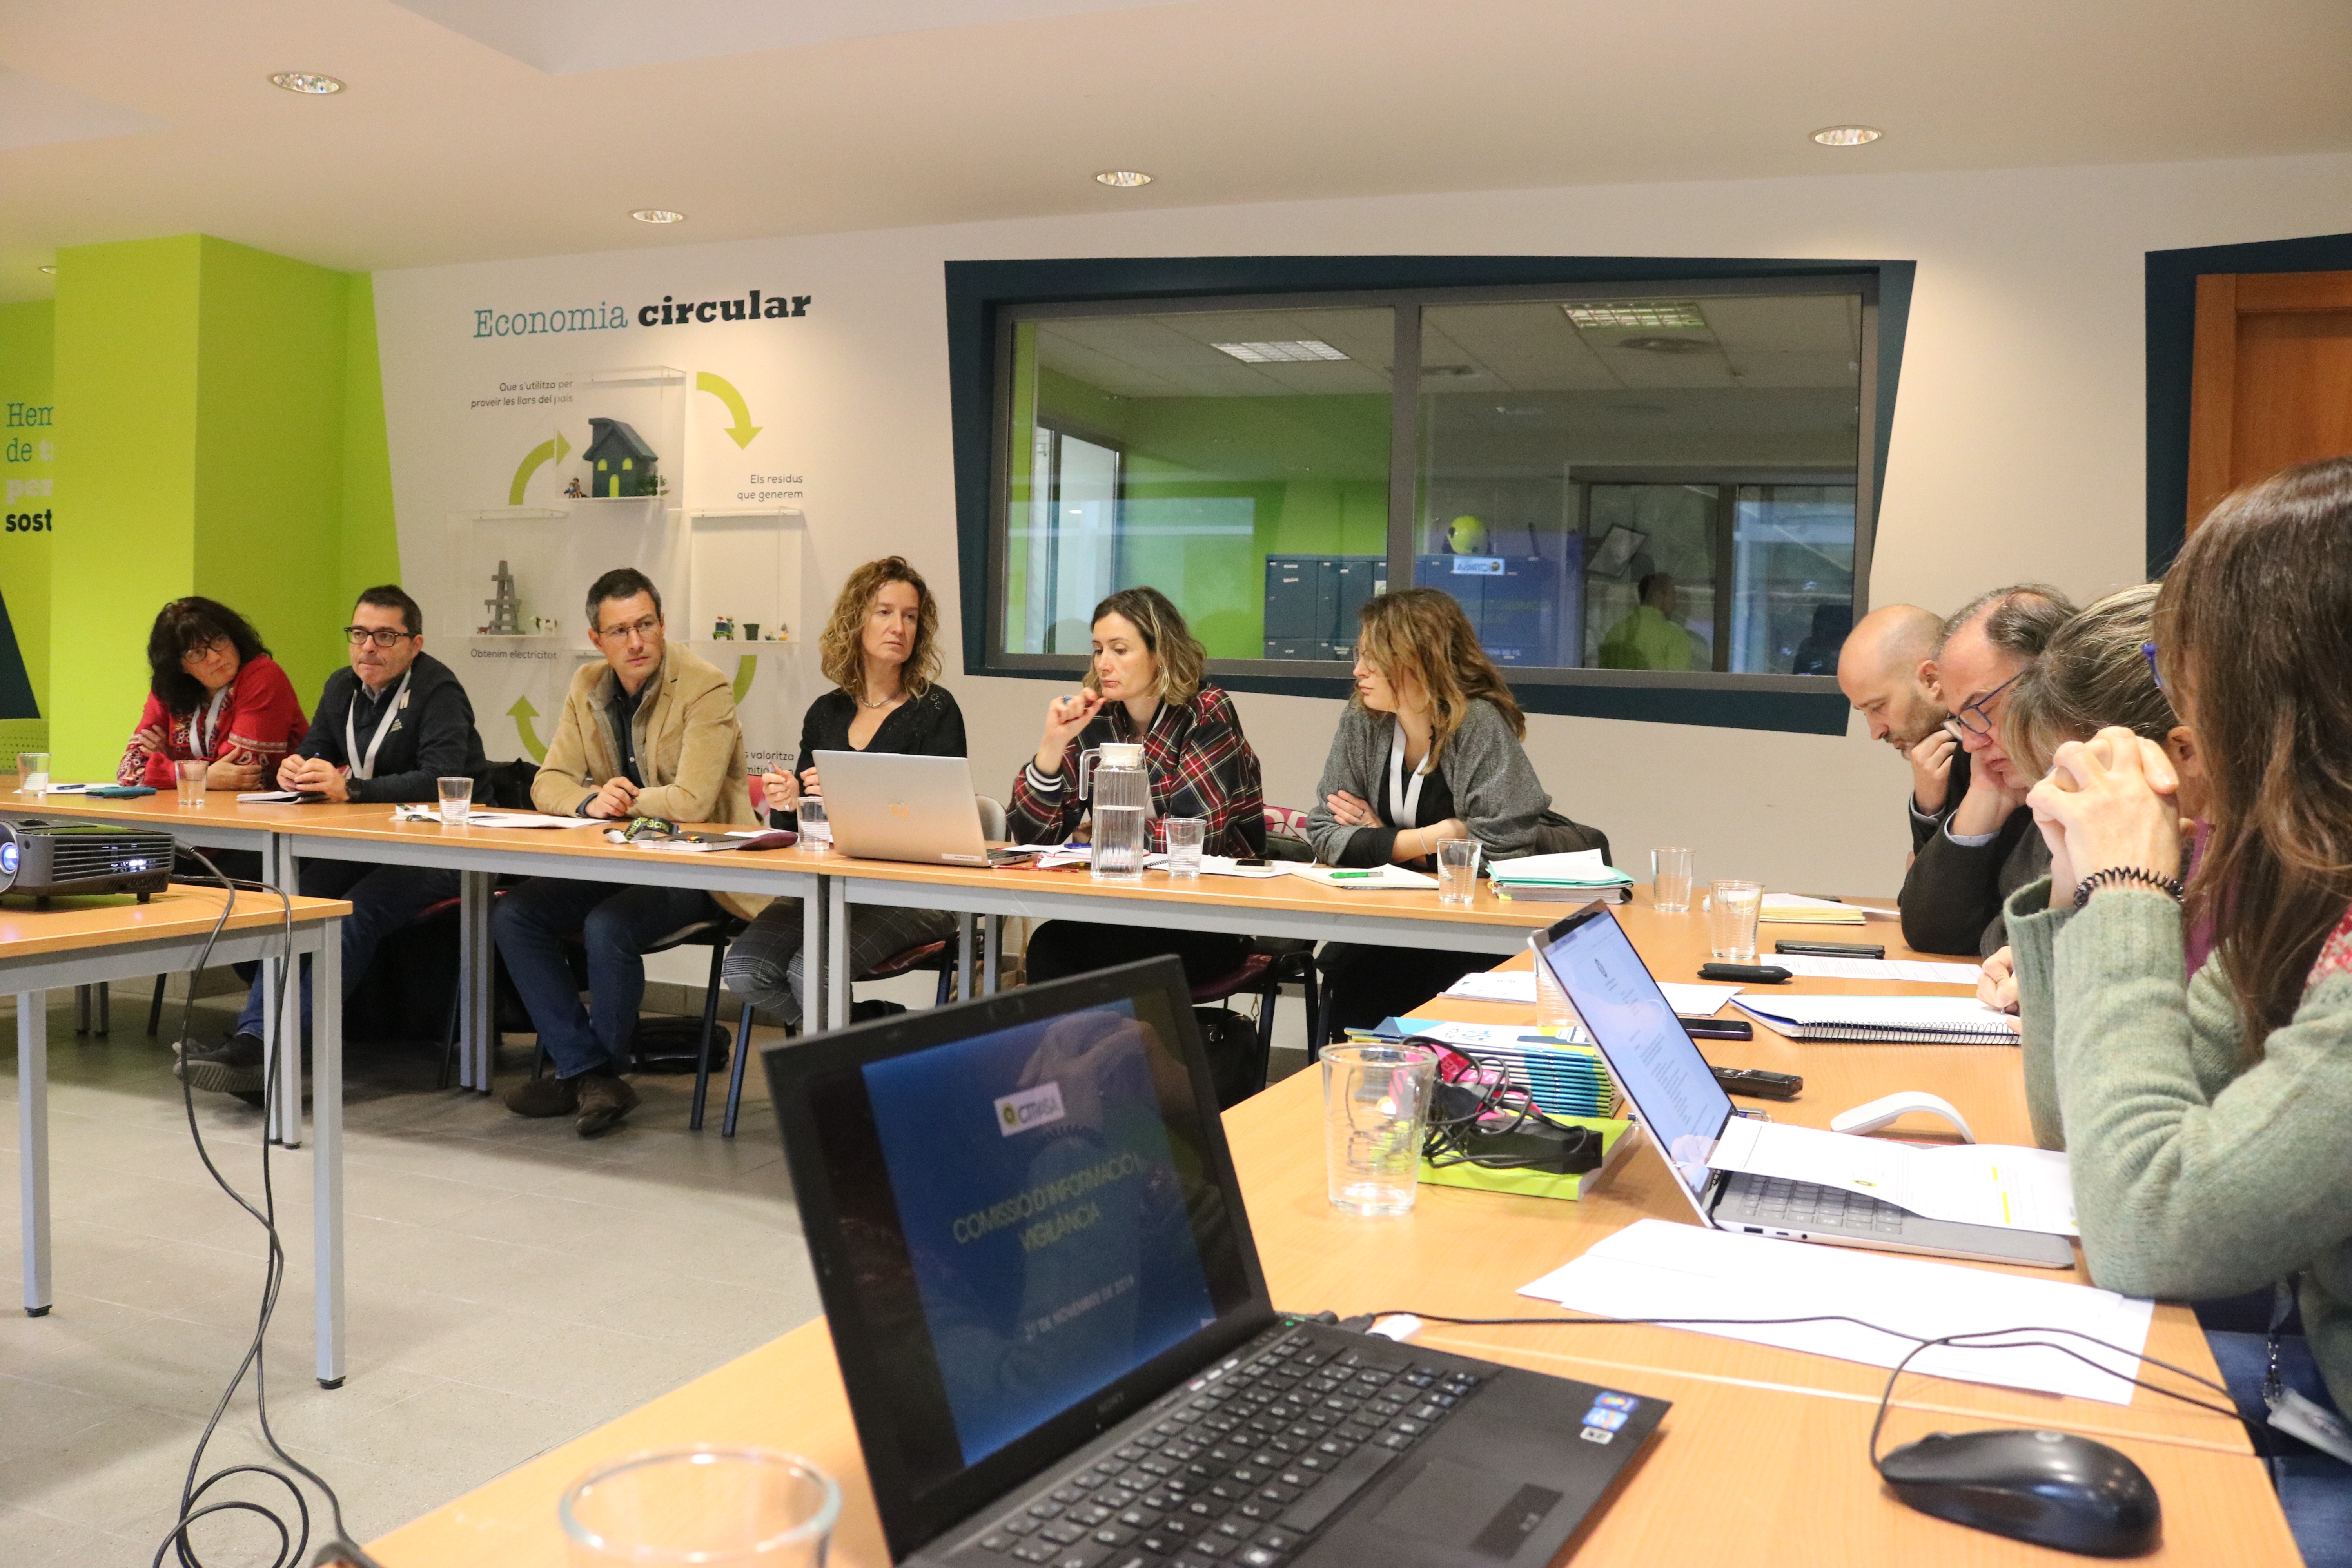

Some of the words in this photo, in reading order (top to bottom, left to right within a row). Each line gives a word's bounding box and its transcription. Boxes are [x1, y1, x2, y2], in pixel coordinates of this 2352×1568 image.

[474, 301, 628, 338] Economia
[638, 289, 811, 327] circular
[499, 383, 517, 392] Que
[519, 381, 555, 390] s'utilitza
[558, 380, 573, 390] per
[471, 397, 501, 409] proveir
[503, 397, 515, 405] les
[517, 396, 536, 405] llars
[538, 394, 552, 403] del
[6, 438, 32, 463] de
[751, 474, 764, 484] Els
[767, 474, 803, 483] residus
[737, 492, 755, 502] que
[759, 491, 803, 502] generem
[470, 648, 508, 658] Obtenim
[510, 649, 557, 659] electricitat
[751, 750, 794, 760] valoritza
